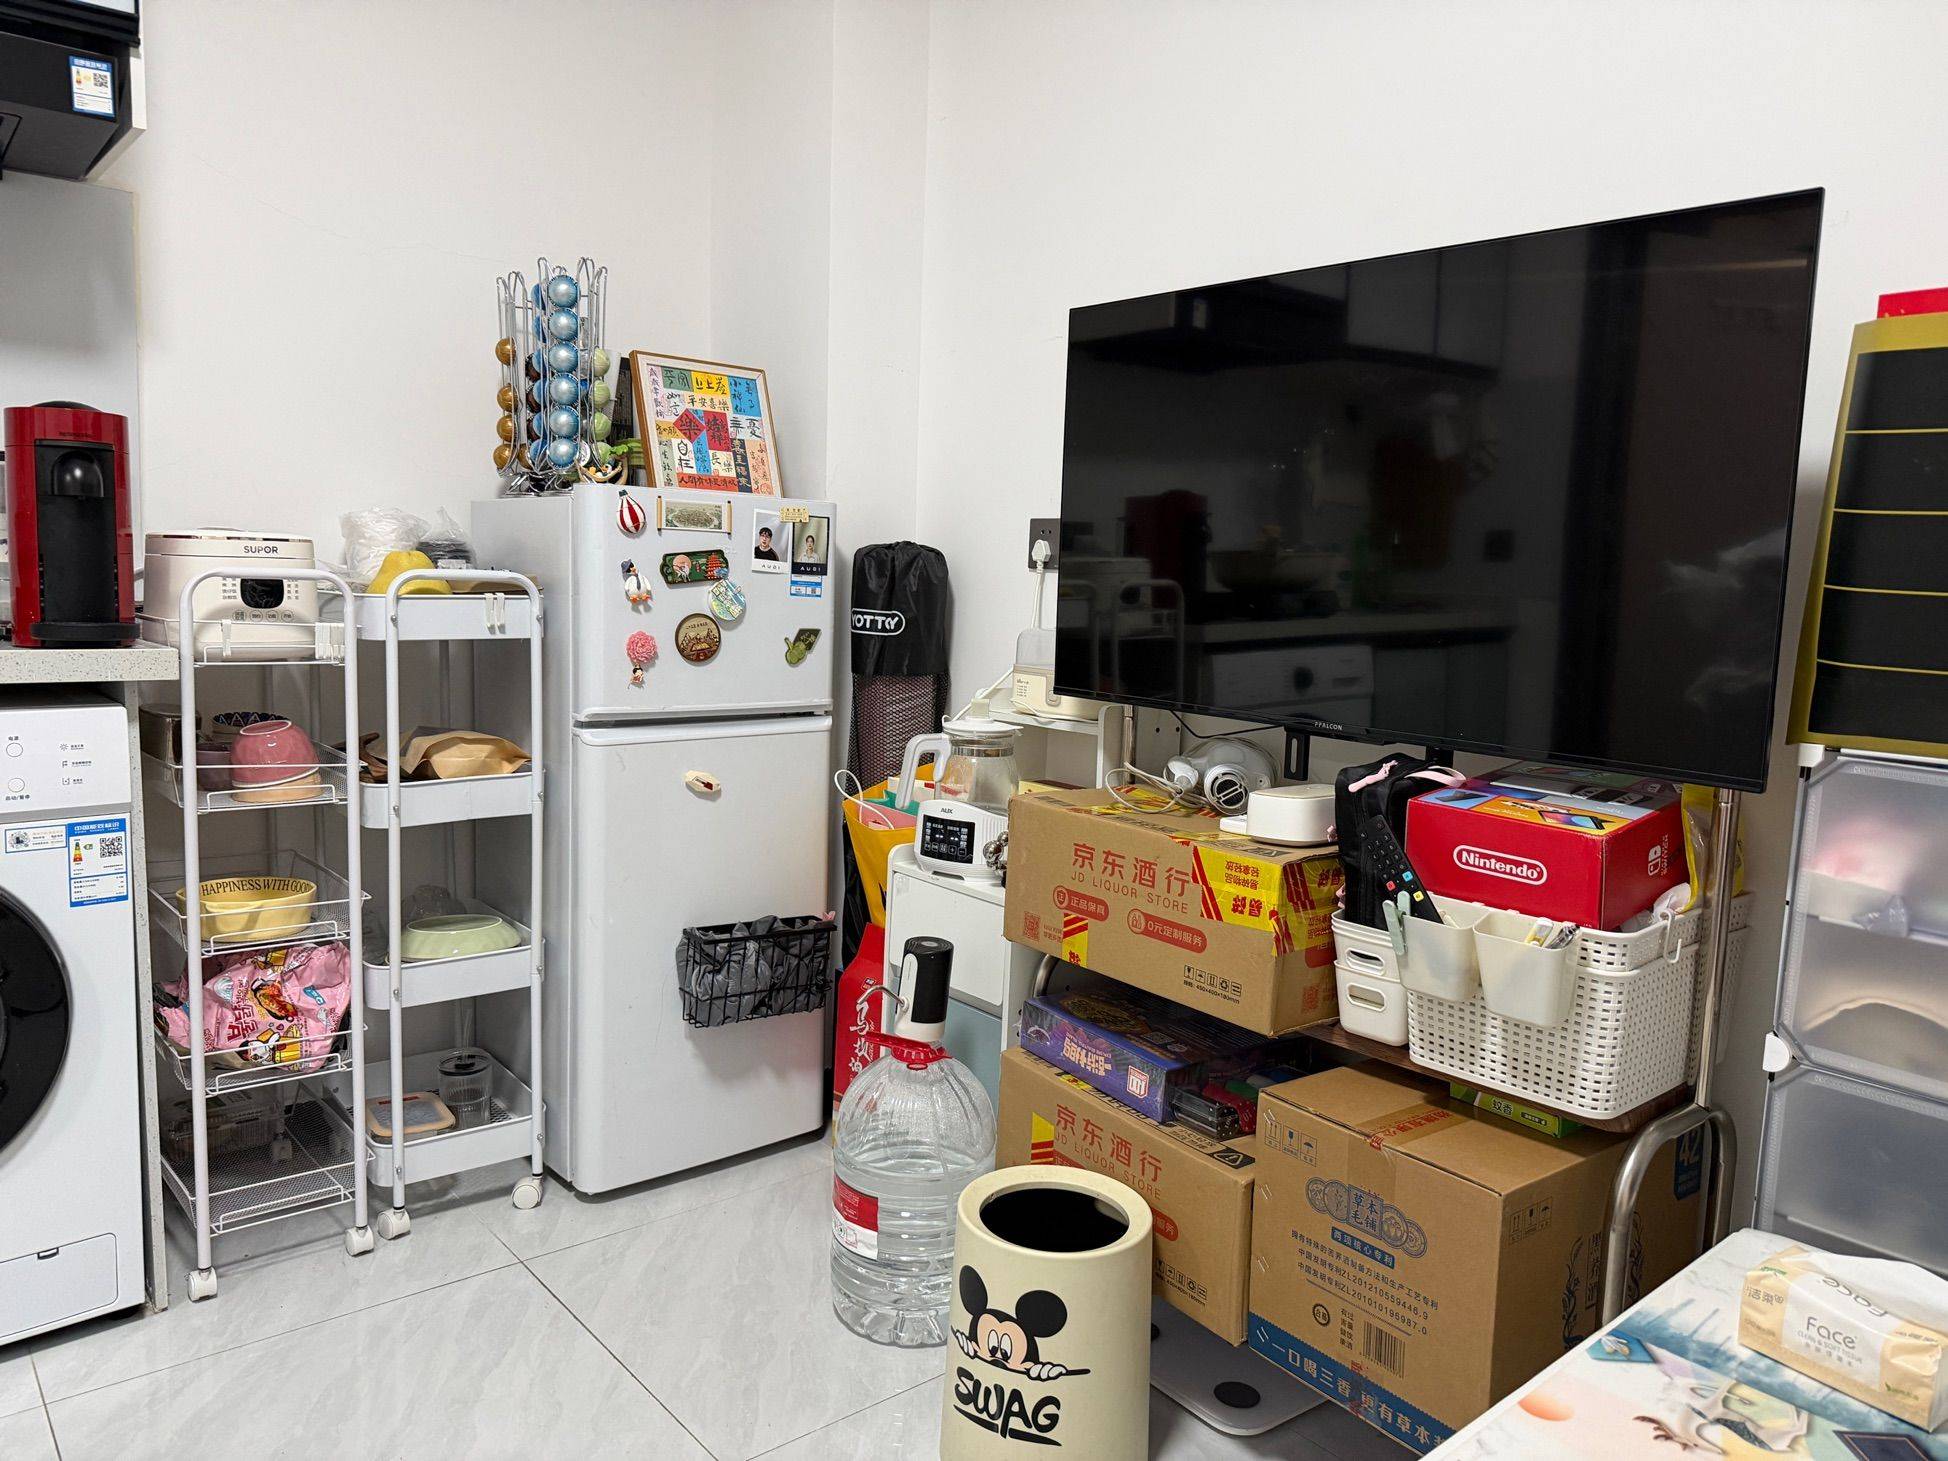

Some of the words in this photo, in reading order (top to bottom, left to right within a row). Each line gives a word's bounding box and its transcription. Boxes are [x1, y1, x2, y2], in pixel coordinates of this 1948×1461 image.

[243, 545, 279, 554] SUPOR
[1072, 842, 1190, 898] 京东酒行
[1461, 850, 1539, 879] Nintendo
[201, 878, 262, 897] HAPPINESS
[262, 878, 291, 893] WITH
[1071, 871, 1085, 883] JD
[1092, 875, 1138, 899] LIQUOR
[1146, 892, 1189, 914] STORE
[1071, 896, 1105, 916] 正品保真
[1056, 1103, 1162, 1182] 京东酒行
[1074, 1142, 1116, 1174] LIQUOR
[1123, 1170, 1161, 1199] STORE
[1353, 1192, 1379, 1215] 草本
[1351, 1209, 1377, 1232] 毛铺
[1806, 1316, 1856, 1349] Face
[1272, 1342, 1351, 1399] 一口喝三香
[954, 1366, 1061, 1439] SWAG
